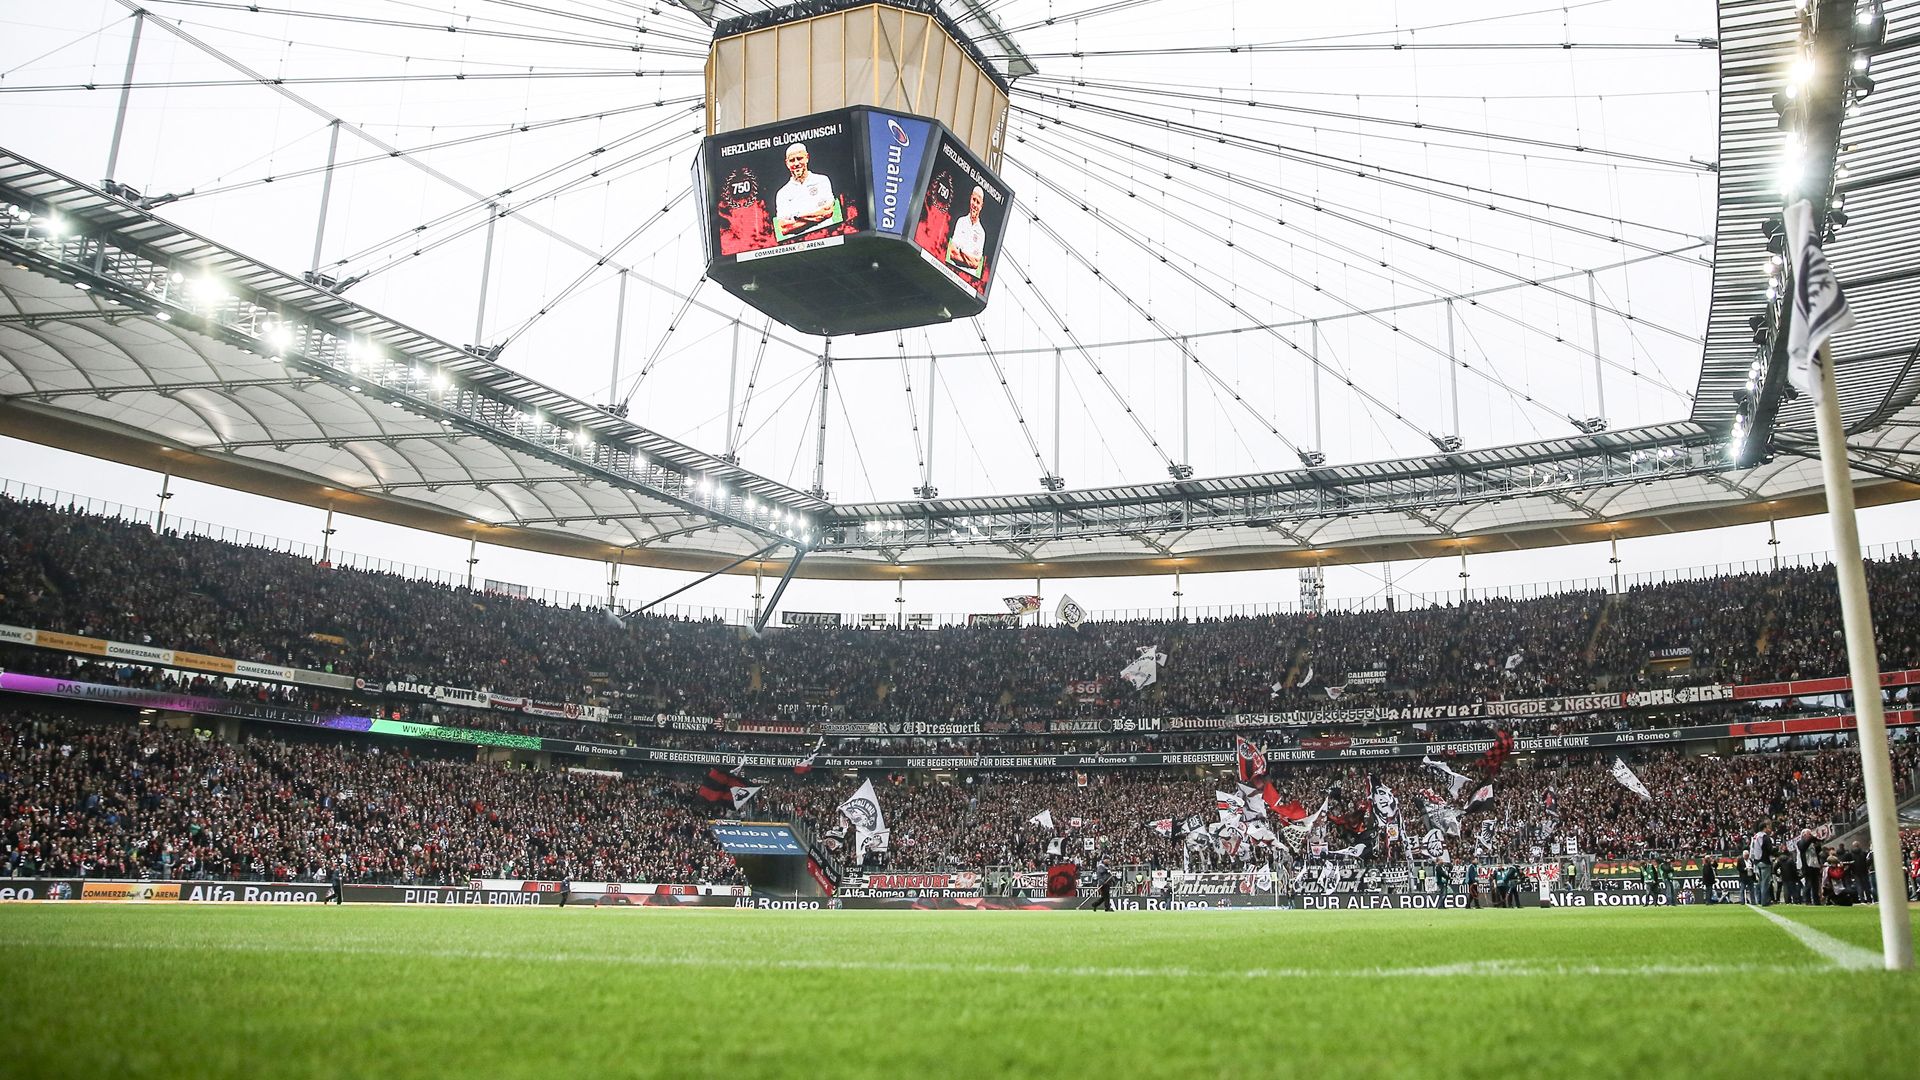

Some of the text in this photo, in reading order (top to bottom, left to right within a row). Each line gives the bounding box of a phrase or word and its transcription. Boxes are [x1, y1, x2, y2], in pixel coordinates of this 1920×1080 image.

[721, 137, 771, 157] HERZLICHEN
[773, 126, 837, 147] GLÜCKWUNSCH
[942, 142, 970, 175] HERZLICHEN
[732, 181, 751, 195] 750
[881, 145, 903, 230] mainova
[937, 183, 950, 199] 750
[754, 240, 826, 258] COMMERZBANK ARENA
[108, 646, 161, 659] COMMERZBANK
[237, 665, 284, 677] COMMERZBANK
[57, 683, 81, 694] DAS
[86, 686, 122, 698] MULTI
[397, 681, 433, 695] BLACK
[444, 687, 478, 701] WHITE
[1388, 703, 1483, 720] RANKFURT
[1486, 694, 1621, 716] BRIGADE NASSAU
[666, 714, 714, 725] COMMANDO
[672, 722, 708, 731] GIESSEN
[1051, 719, 1100, 731] RAGAZZI
[1169, 717, 1226, 730] Binding
[574, 744, 590, 754] Alfa
[591, 746, 618, 755] Romeo
[650, 751, 668, 761] PURE
[669, 752, 721, 764] BEGEISTERUNG
[722, 754, 736, 764] FÜR
[737, 755, 757, 765] DESE
[760, 757, 776, 766] EINE
[777, 757, 801, 766] KURVE
[825, 758, 842, 766] Alfa
[907, 758, 925, 767] PURE
[927, 758, 978, 767] BEGEISTERUNG
[980, 757, 993, 767] FÜR
[995, 758, 1015, 767] DIESE
[1017, 757, 1032, 766] EINE
[1034, 757, 1057, 766] KURVE
[1079, 756, 1096, 764] Alfa
[1098, 756, 1127, 764] Romeo
[1162, 755, 1182, 764] PURE
[1182, 753, 1235, 763] BEGEISTERUNG
[1274, 752, 1291, 760] EINE
[1292, 750, 1316, 760] KURVE
[1340, 749, 1358, 757] Alfa
[1360, 747, 1390, 756] Romeo
[1521, 738, 1543, 749] DIESE
[1544, 737, 1563, 749] EINE
[1563, 736, 1589, 746] KURVE
[1616, 734, 1635, 743] Alfa
[1638, 732, 1670, 742] Romeo
[716, 828, 769, 838] Helaba
[723, 841, 778, 849] Helaba
[868, 874, 950, 889] FRANKFURT
[155, 891, 179, 899] ARENA
[188, 885, 318, 903] Alfa Romeo
[404, 889, 541, 905] PUR ALFA ROMEO
[843, 888, 978, 898] Alfa Romeo Alfa Romeo
[1549, 893, 1586, 906] Alfa
[734, 897, 820, 910] Alfa Romeo
[1108, 898, 1208, 911] Alfa Romeo
[1303, 895, 1468, 909] PUR ALFA ROMEO
